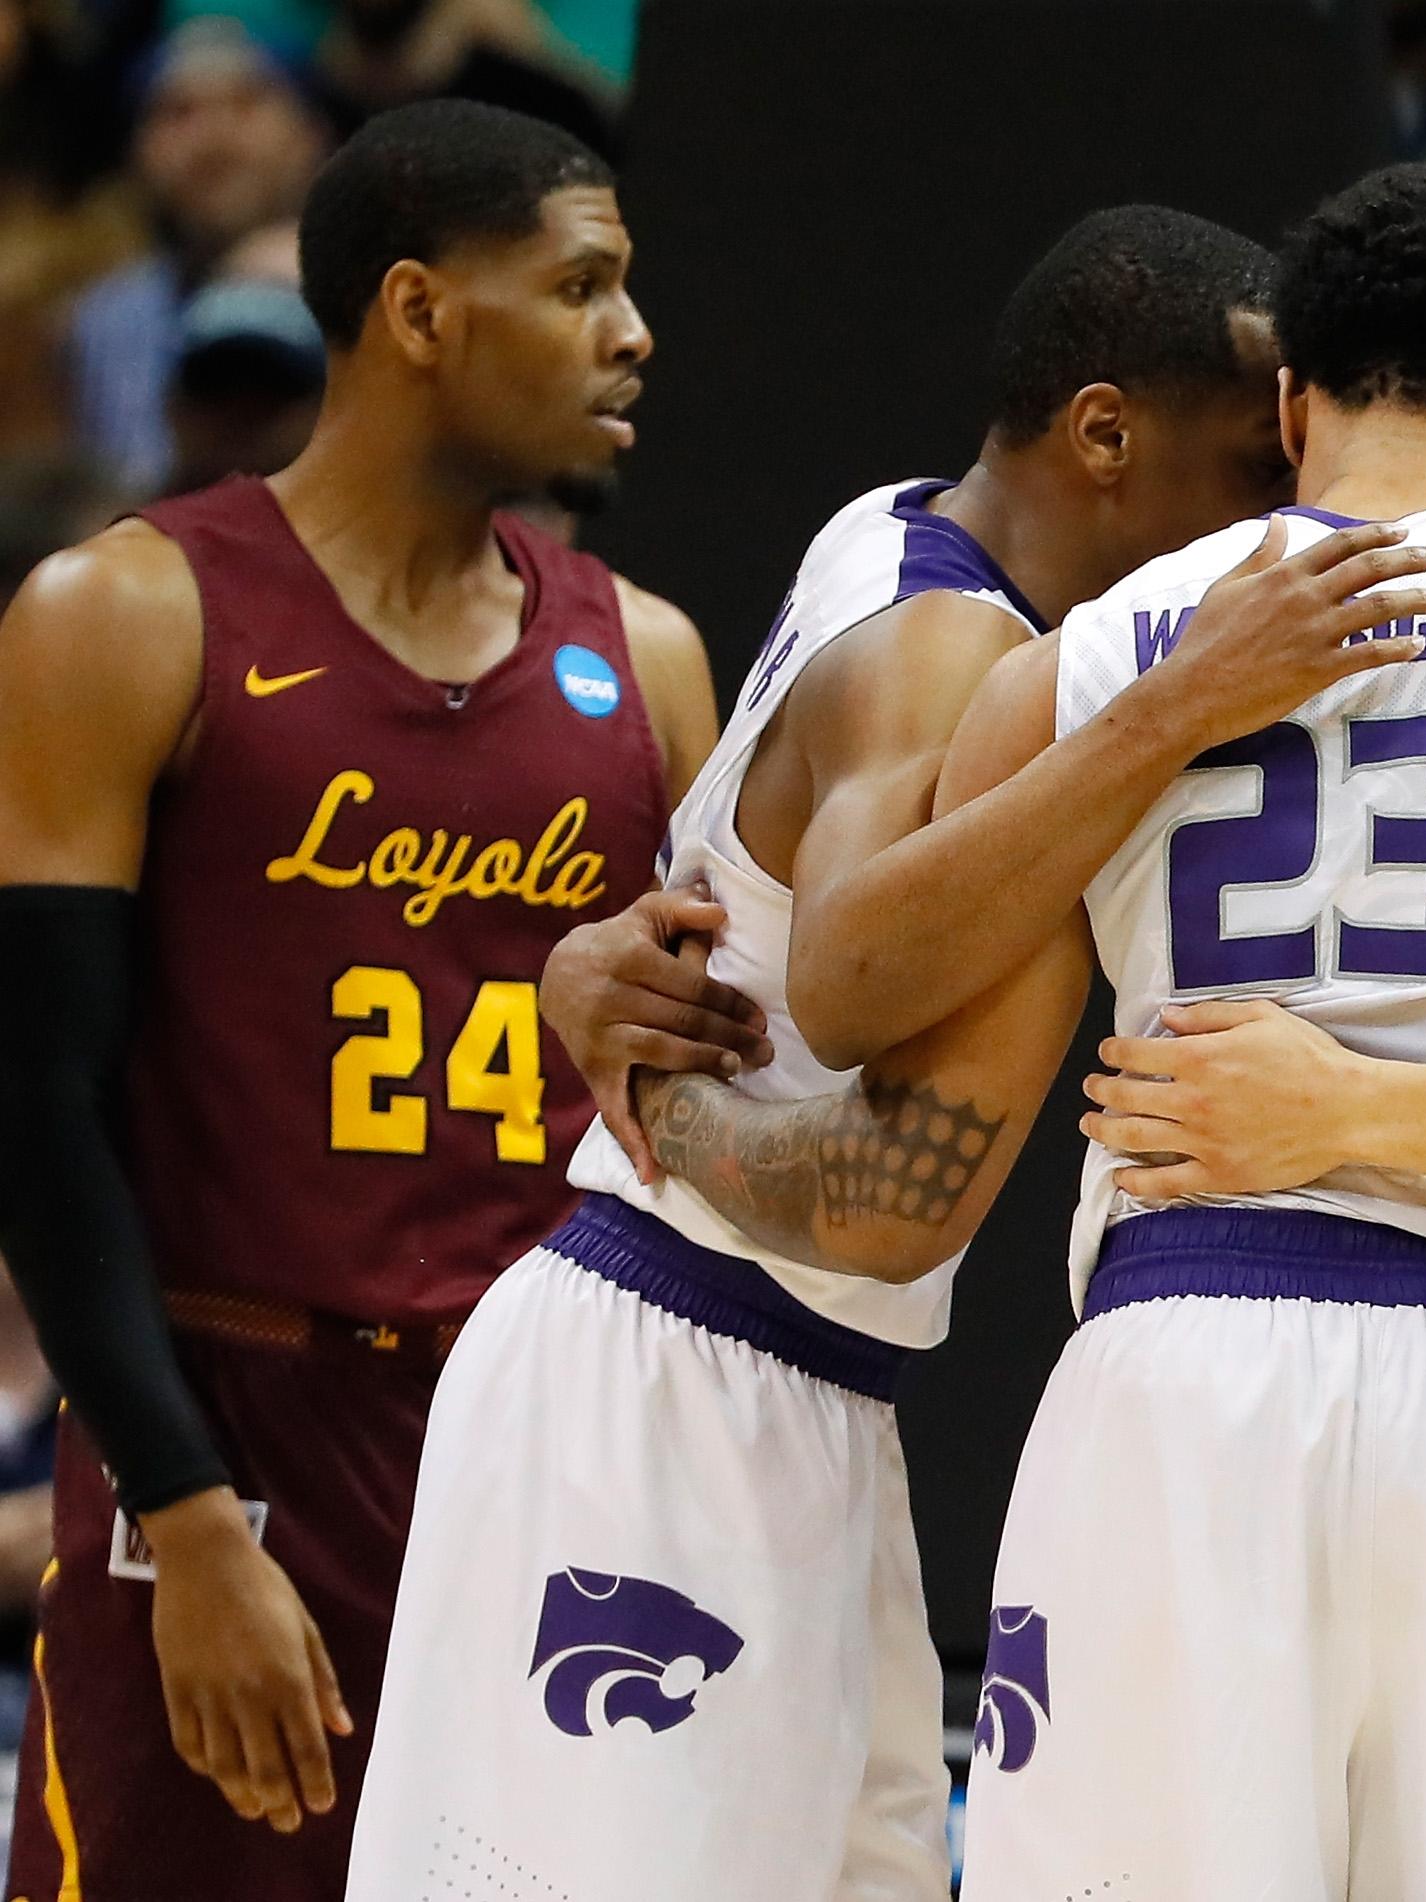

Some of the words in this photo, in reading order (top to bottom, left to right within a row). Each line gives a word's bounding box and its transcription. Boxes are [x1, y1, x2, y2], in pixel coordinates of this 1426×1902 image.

[564, 673, 619, 702] NCAA
[265, 769, 607, 928] Loyola
[330, 964, 546, 1165] 24
